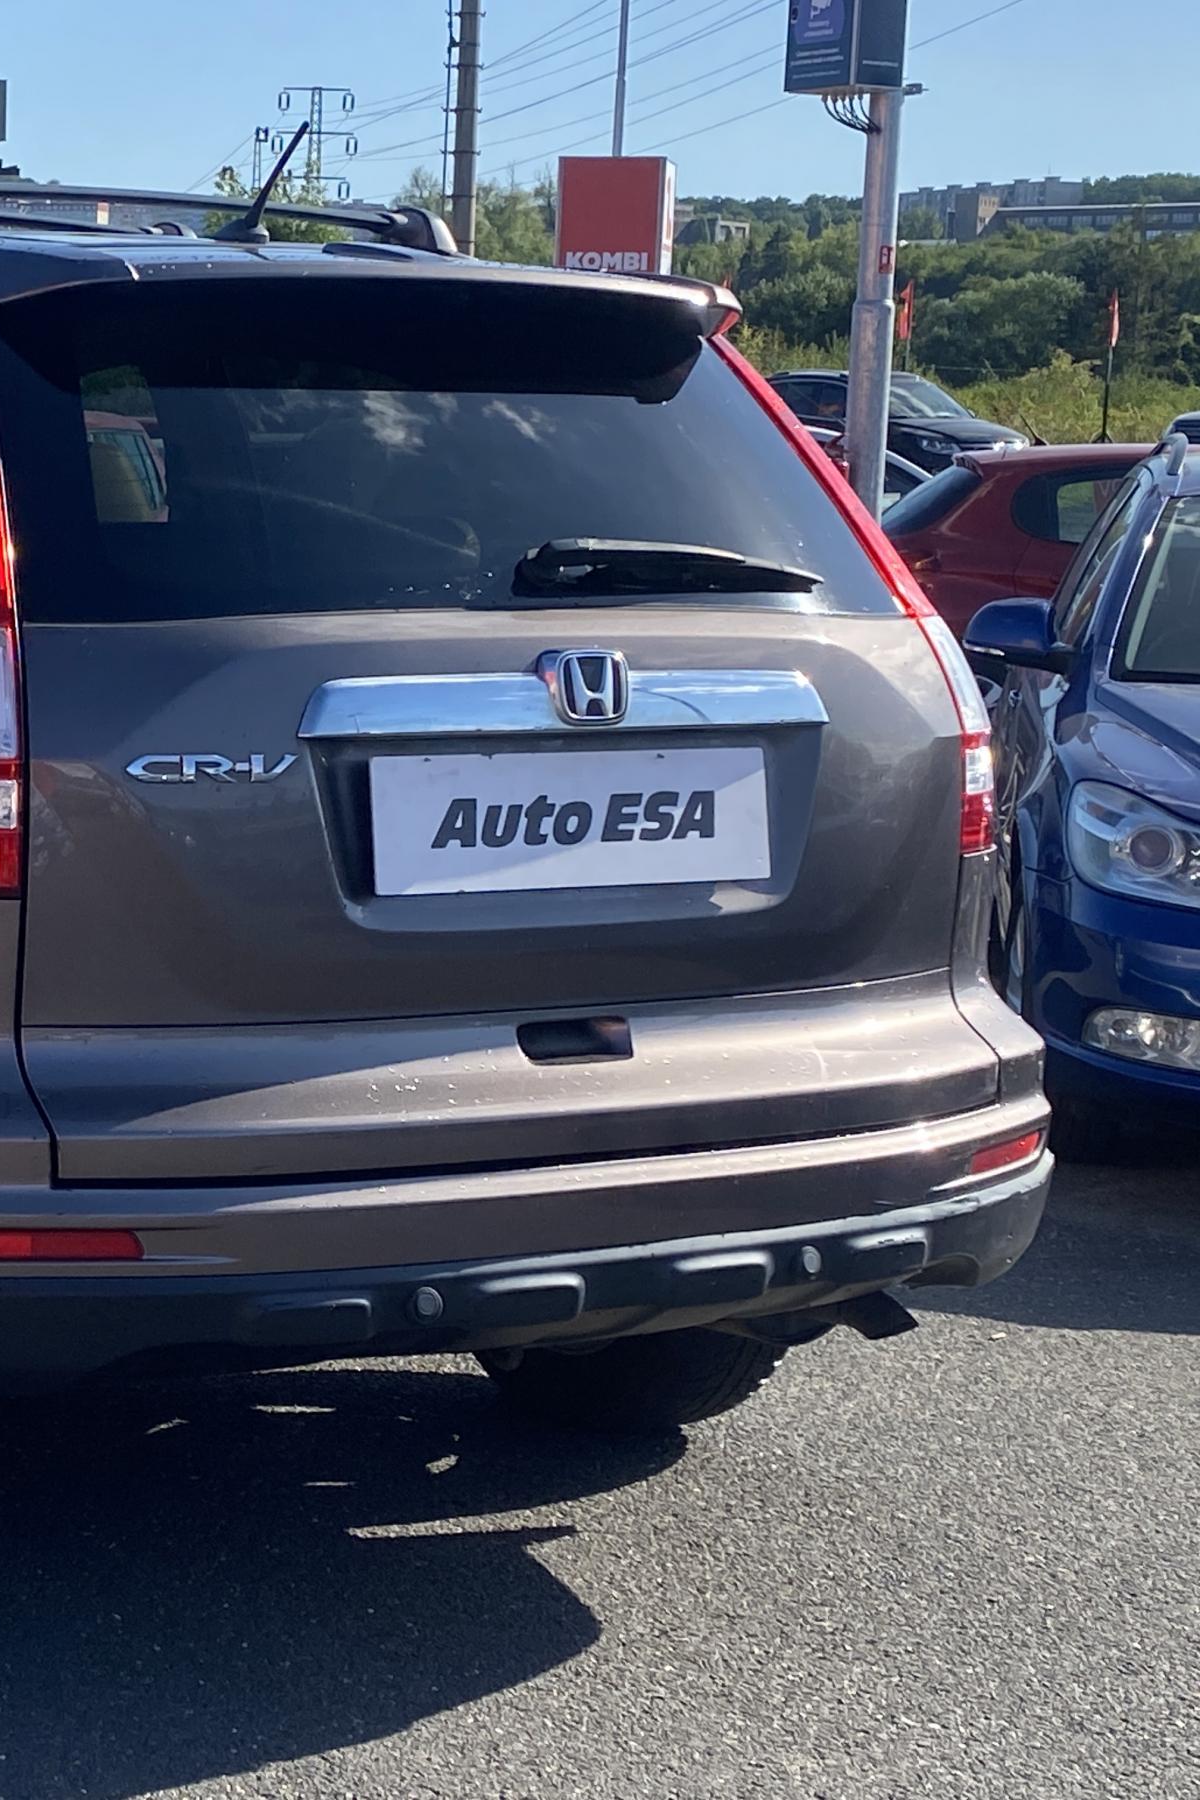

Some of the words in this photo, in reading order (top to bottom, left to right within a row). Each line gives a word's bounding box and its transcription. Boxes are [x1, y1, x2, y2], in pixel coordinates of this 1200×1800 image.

[565, 251, 648, 271] KOMBI
[126, 754, 299, 783] CR-V
[431, 795, 593, 849] Auto
[601, 790, 715, 843] ESA
